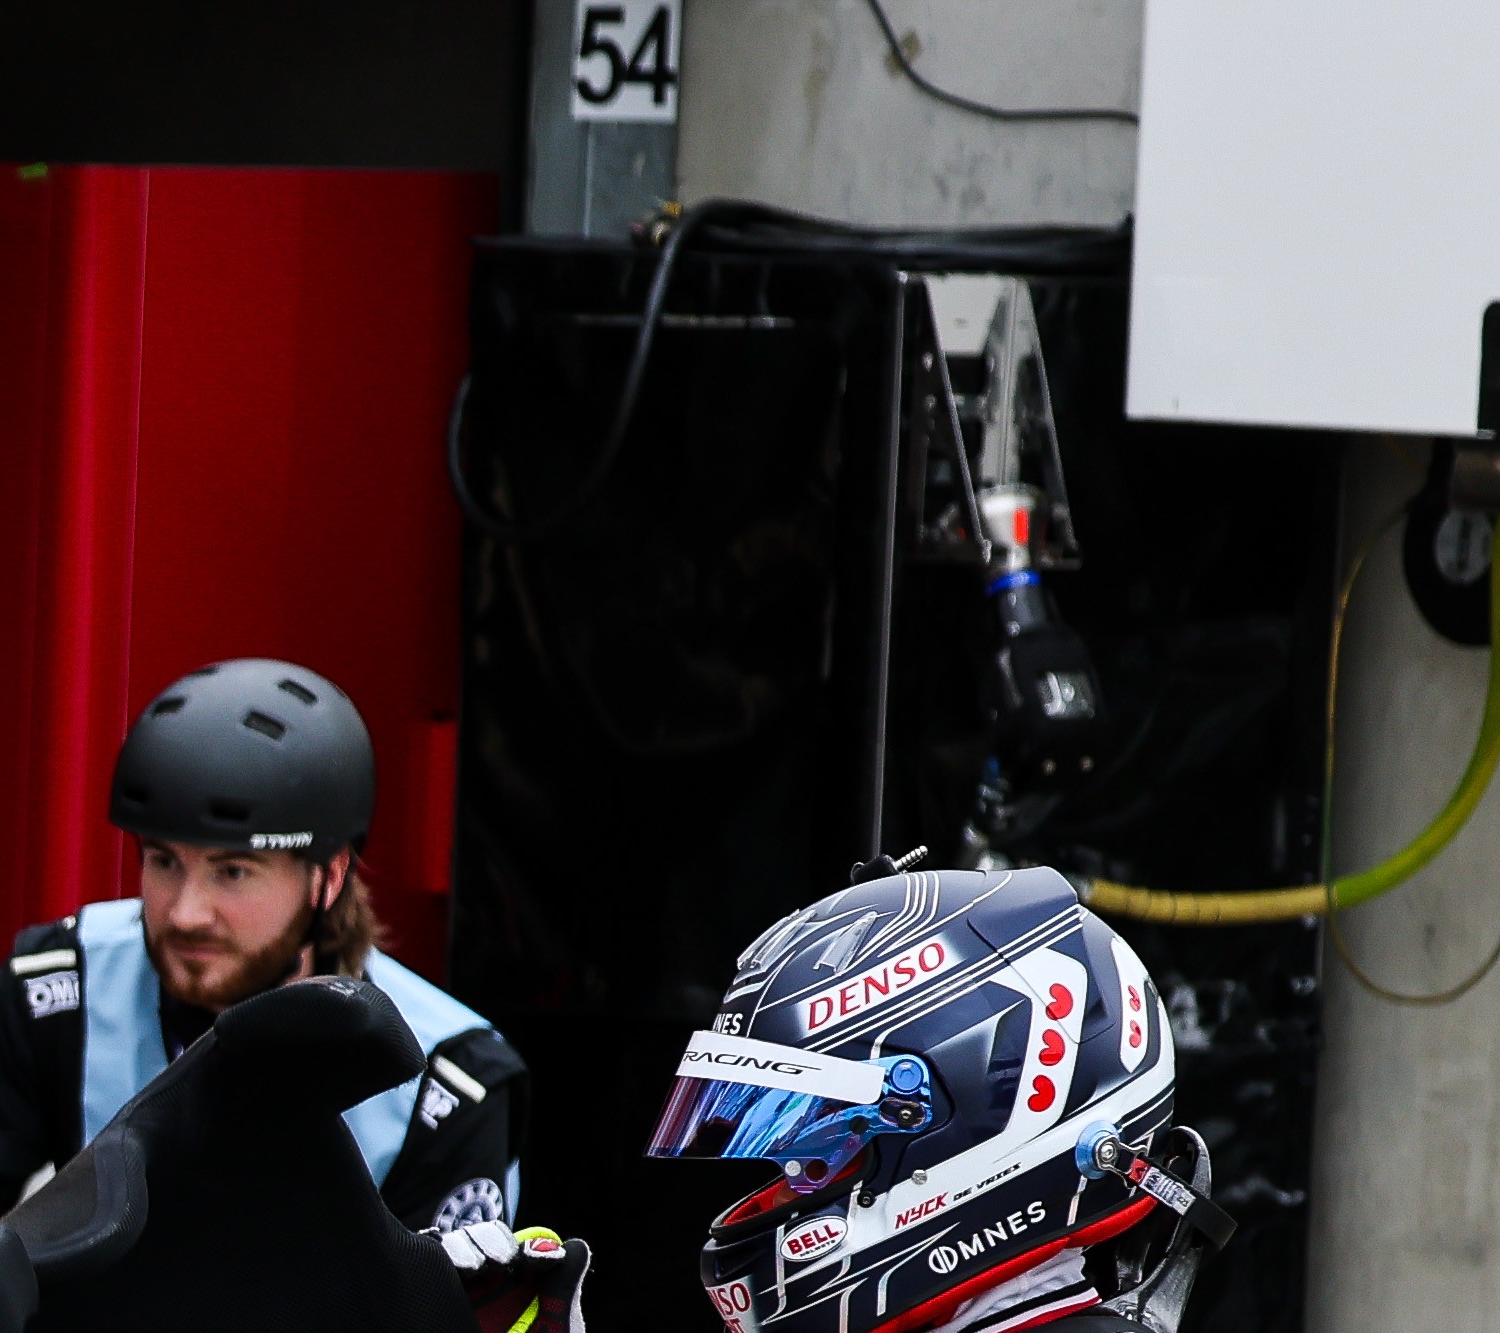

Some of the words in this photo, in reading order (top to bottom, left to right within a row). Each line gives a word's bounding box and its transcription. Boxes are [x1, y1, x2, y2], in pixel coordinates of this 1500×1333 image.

[573, 6, 677, 107] 54
[807, 942, 946, 1032] DENSO
[895, 1192, 948, 1230] NYCK
[953, 1189, 973, 1202] DE
[974, 1161, 1022, 1190] VRIES
[787, 1223, 842, 1256] BELL
[929, 1200, 1047, 1275] OMNES
